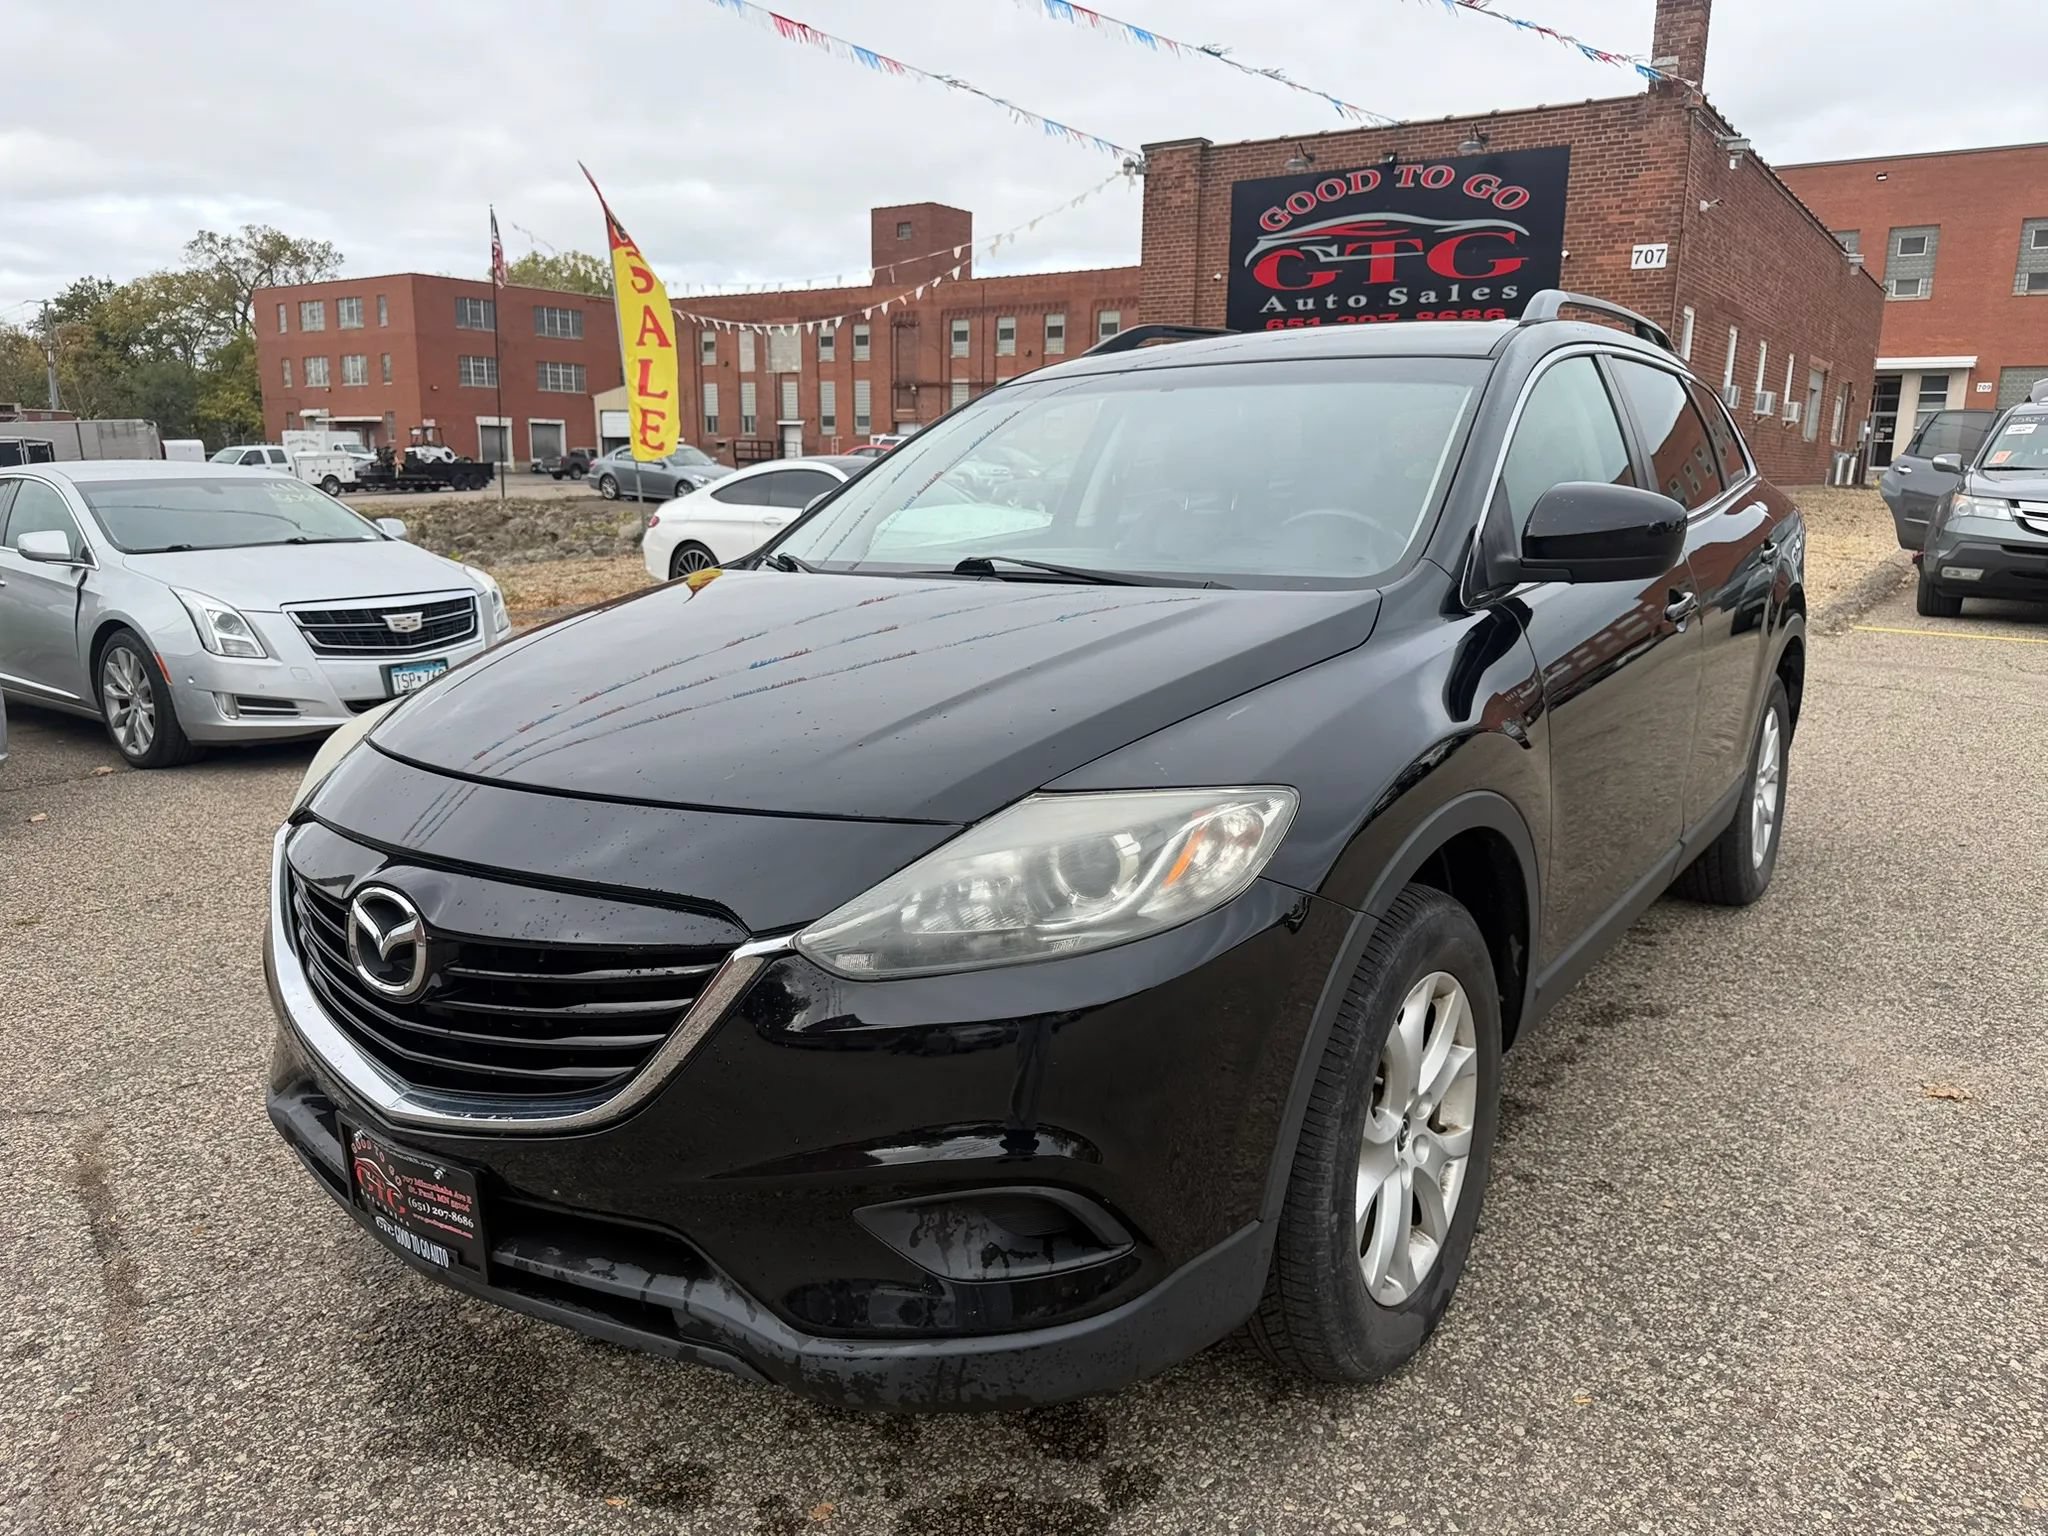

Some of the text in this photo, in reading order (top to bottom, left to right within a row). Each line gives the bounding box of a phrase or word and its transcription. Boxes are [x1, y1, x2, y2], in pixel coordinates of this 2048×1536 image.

[1259, 165, 1530, 231] GOOD TO GO
[1253, 232, 1530, 290] GTG
[1634, 249, 1666, 264] 707
[1259, 284, 1518, 313] Auto Sales
[626, 251, 672, 450] SALE
[394, 672, 416, 690] TSP
[408, 1196, 430, 1213] (651)
[432, 1207, 474, 1228] 207-8686
